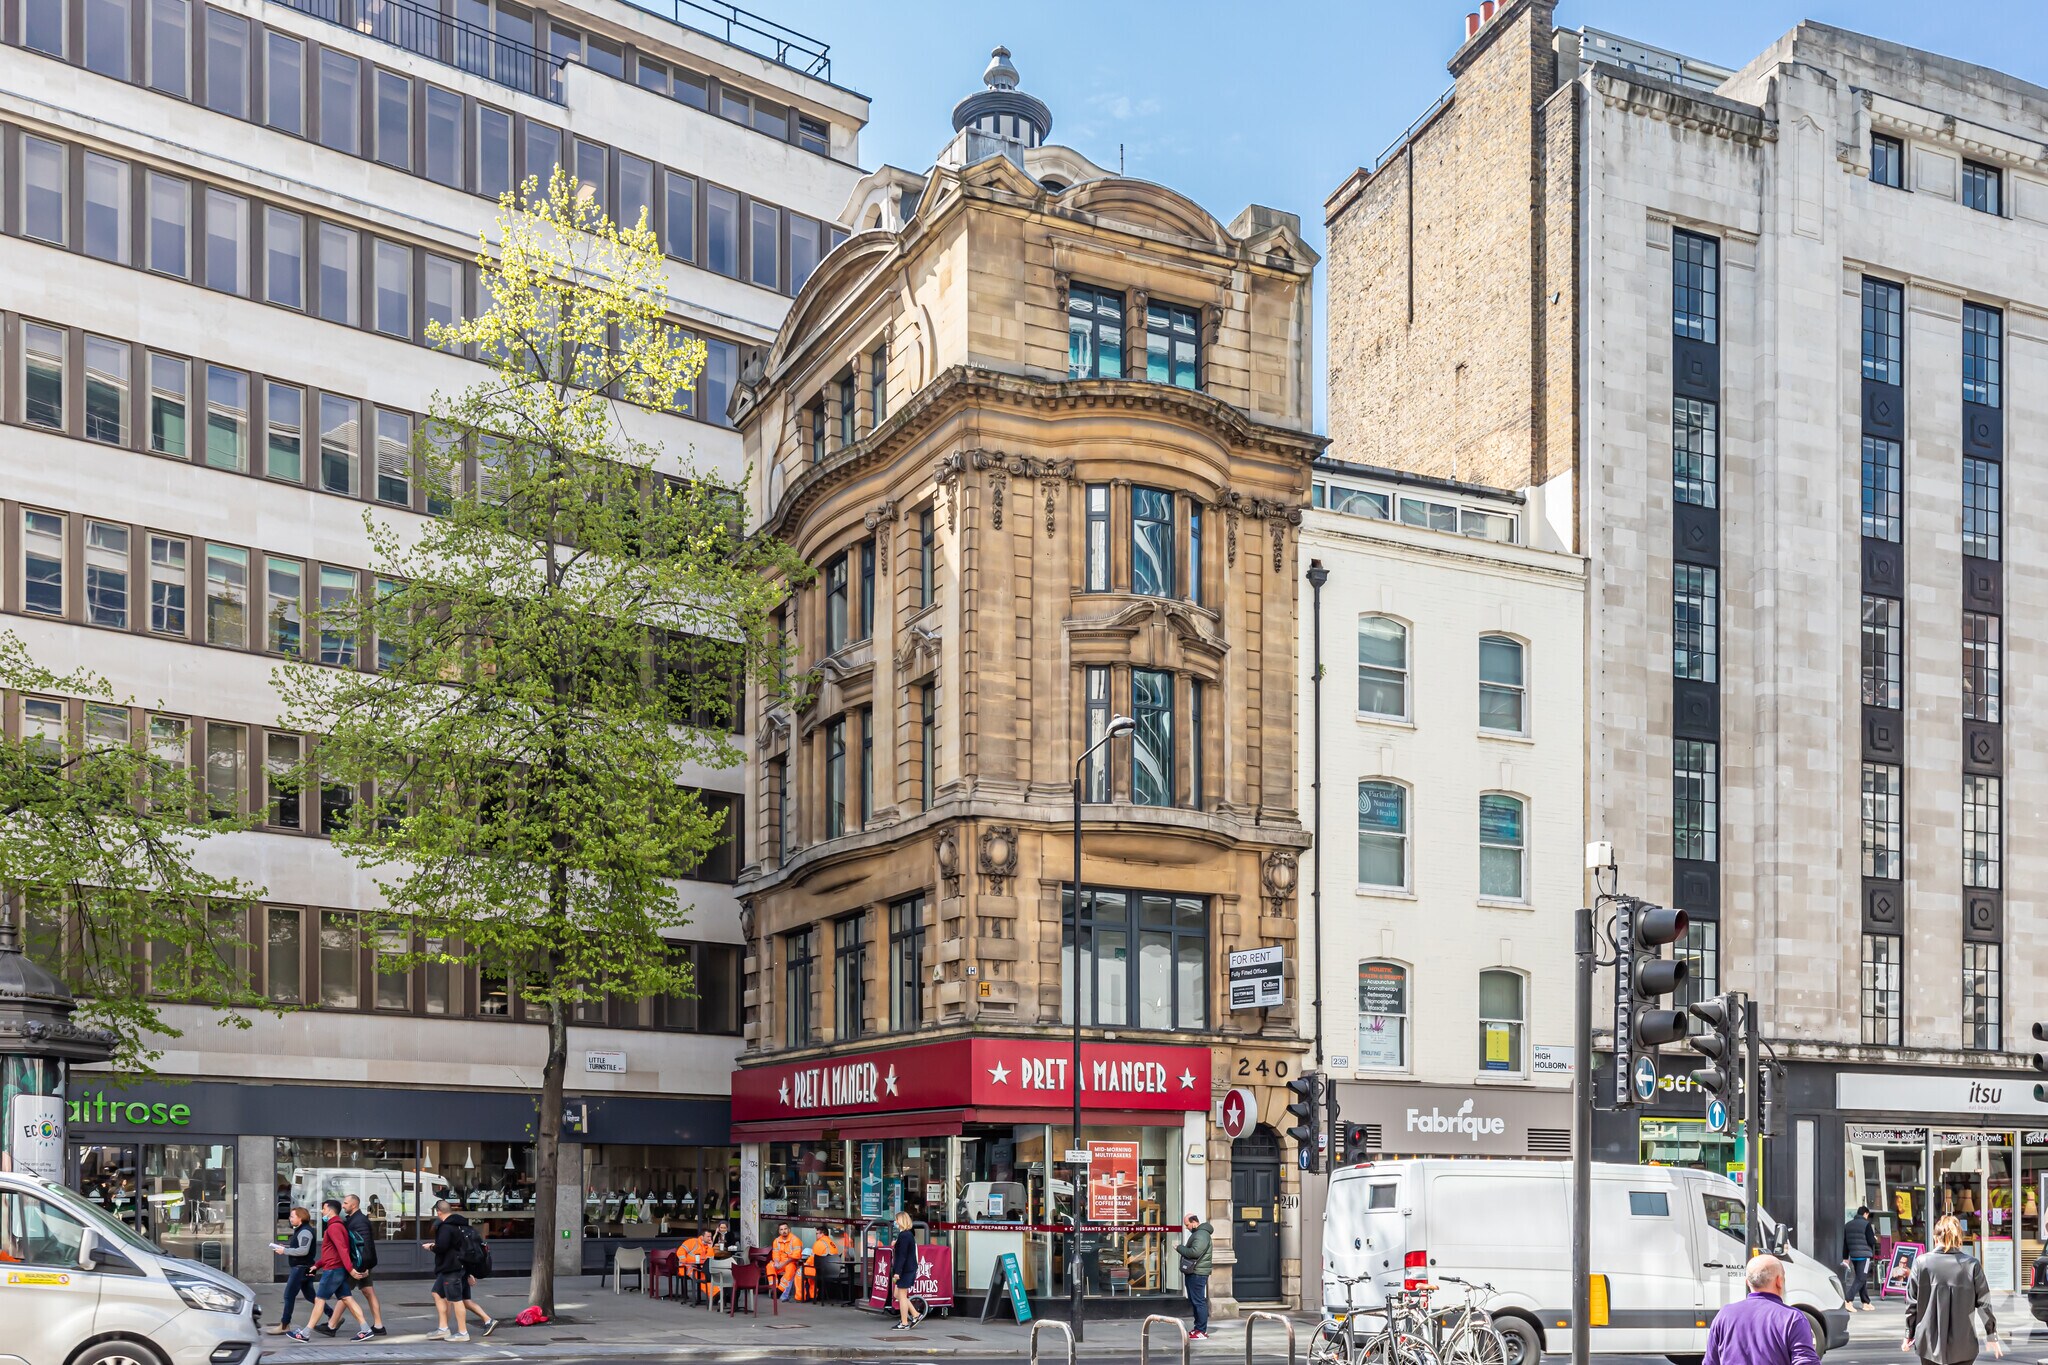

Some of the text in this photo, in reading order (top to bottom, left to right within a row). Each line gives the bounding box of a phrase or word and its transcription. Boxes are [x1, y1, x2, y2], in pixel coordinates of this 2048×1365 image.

[1369, 791, 1397, 799] Parkland
[1374, 800, 1397, 808] Natural
[1377, 809, 1397, 817] Health
[1232, 952, 1270, 965] FOR RENT
[981, 984, 989, 995] H
[1238, 1057, 1288, 1078] 240
[1021, 1057, 1068, 1090] PRET
[1094, 1060, 1167, 1093] MANGER
[794, 1062, 879, 1109] PRET A MANGER
[1969, 1082, 2002, 1103] itsu
[68, 1091, 191, 1125] aitrose
[1407, 1098, 1505, 1141] Fabrique
[1947, 1134, 1966, 1142] soups
[1984, 1134, 2002, 1142] bowls
[1281, 1196, 1299, 1209] 240
